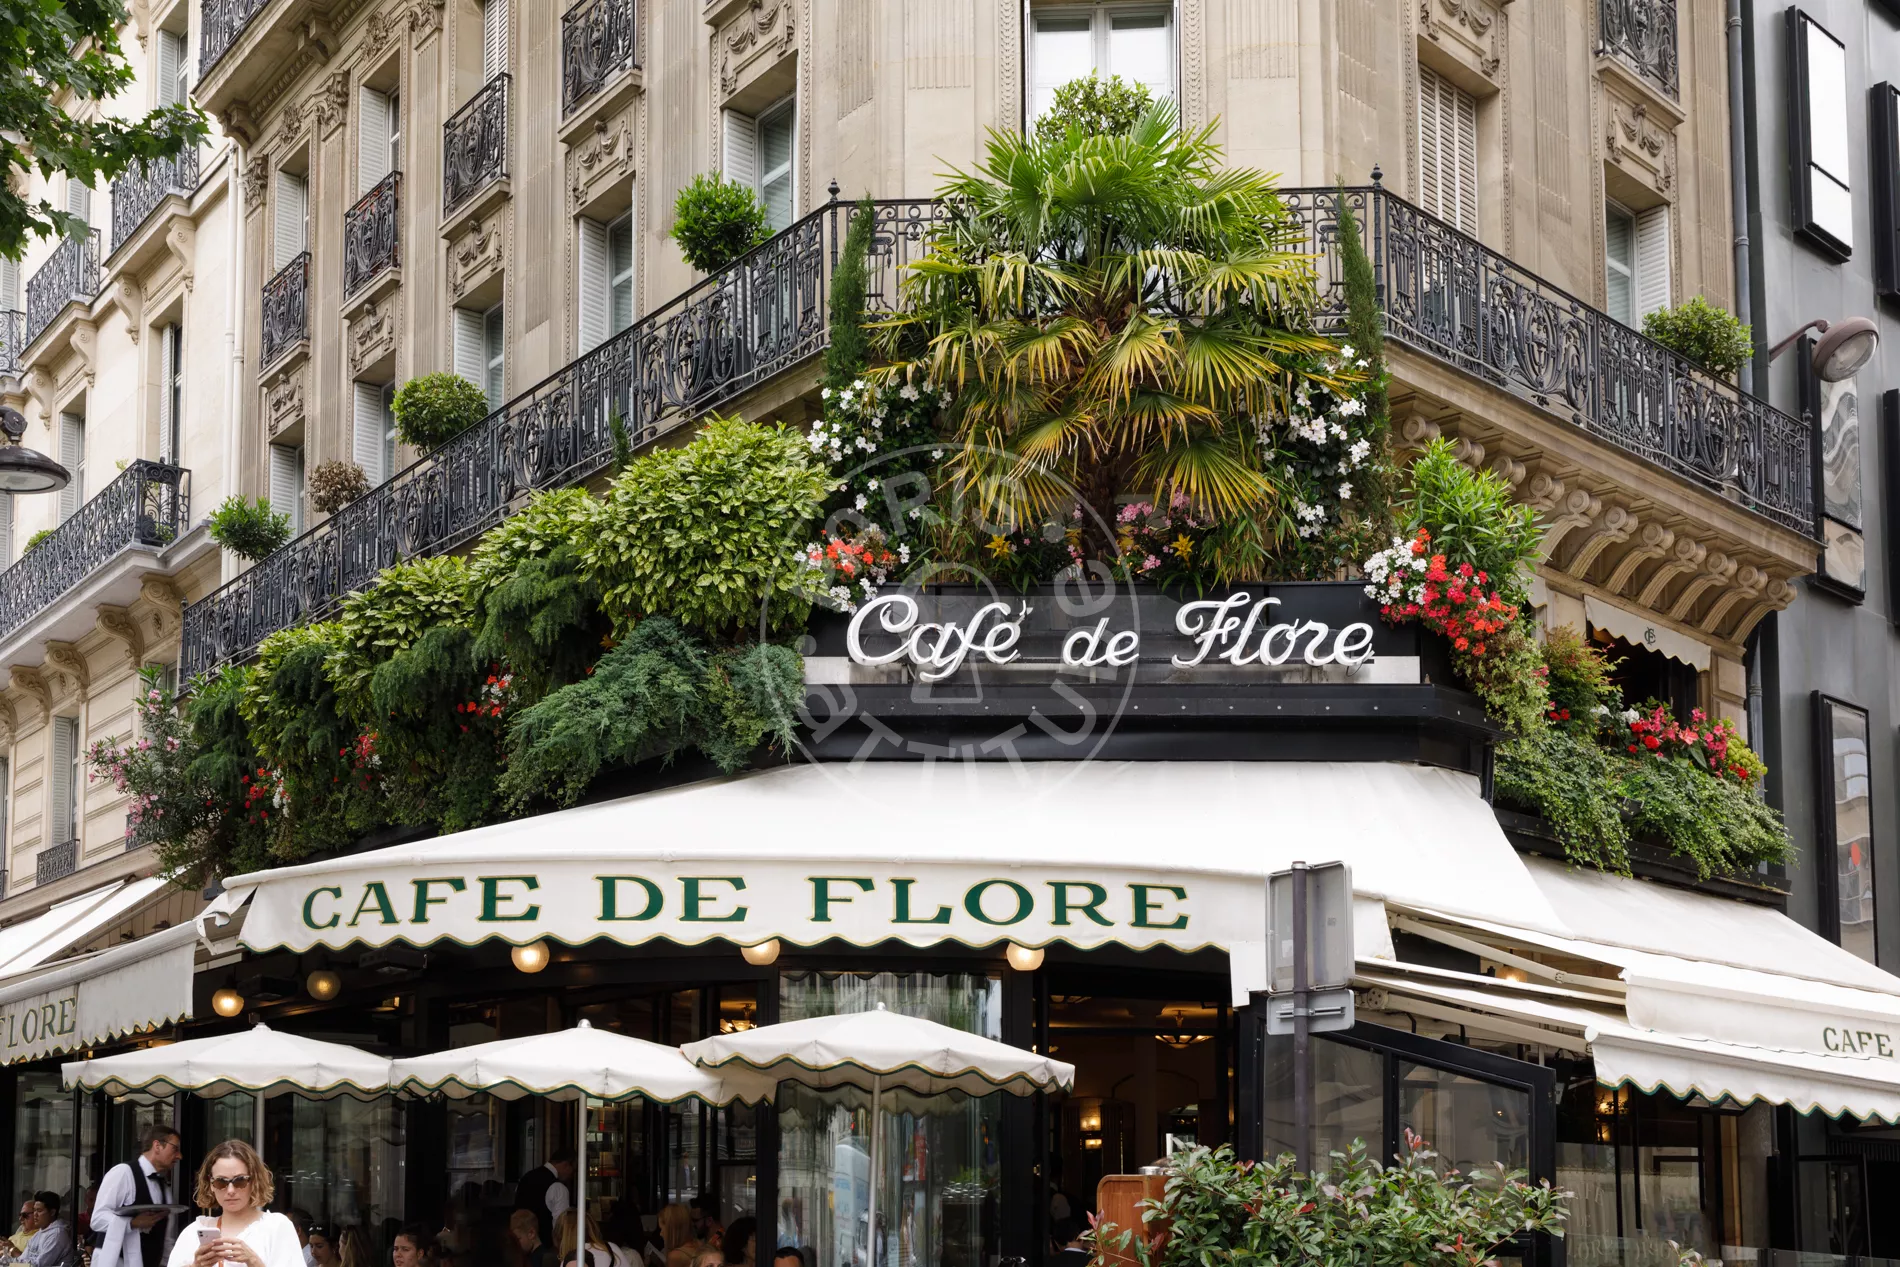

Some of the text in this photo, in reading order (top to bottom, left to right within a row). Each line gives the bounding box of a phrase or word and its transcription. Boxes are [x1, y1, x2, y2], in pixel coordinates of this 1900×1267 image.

[847, 592, 1375, 683] Café de Flore
[301, 873, 1191, 931] CAFE DE FLORE
[1822, 1026, 1895, 1058] CAFE
